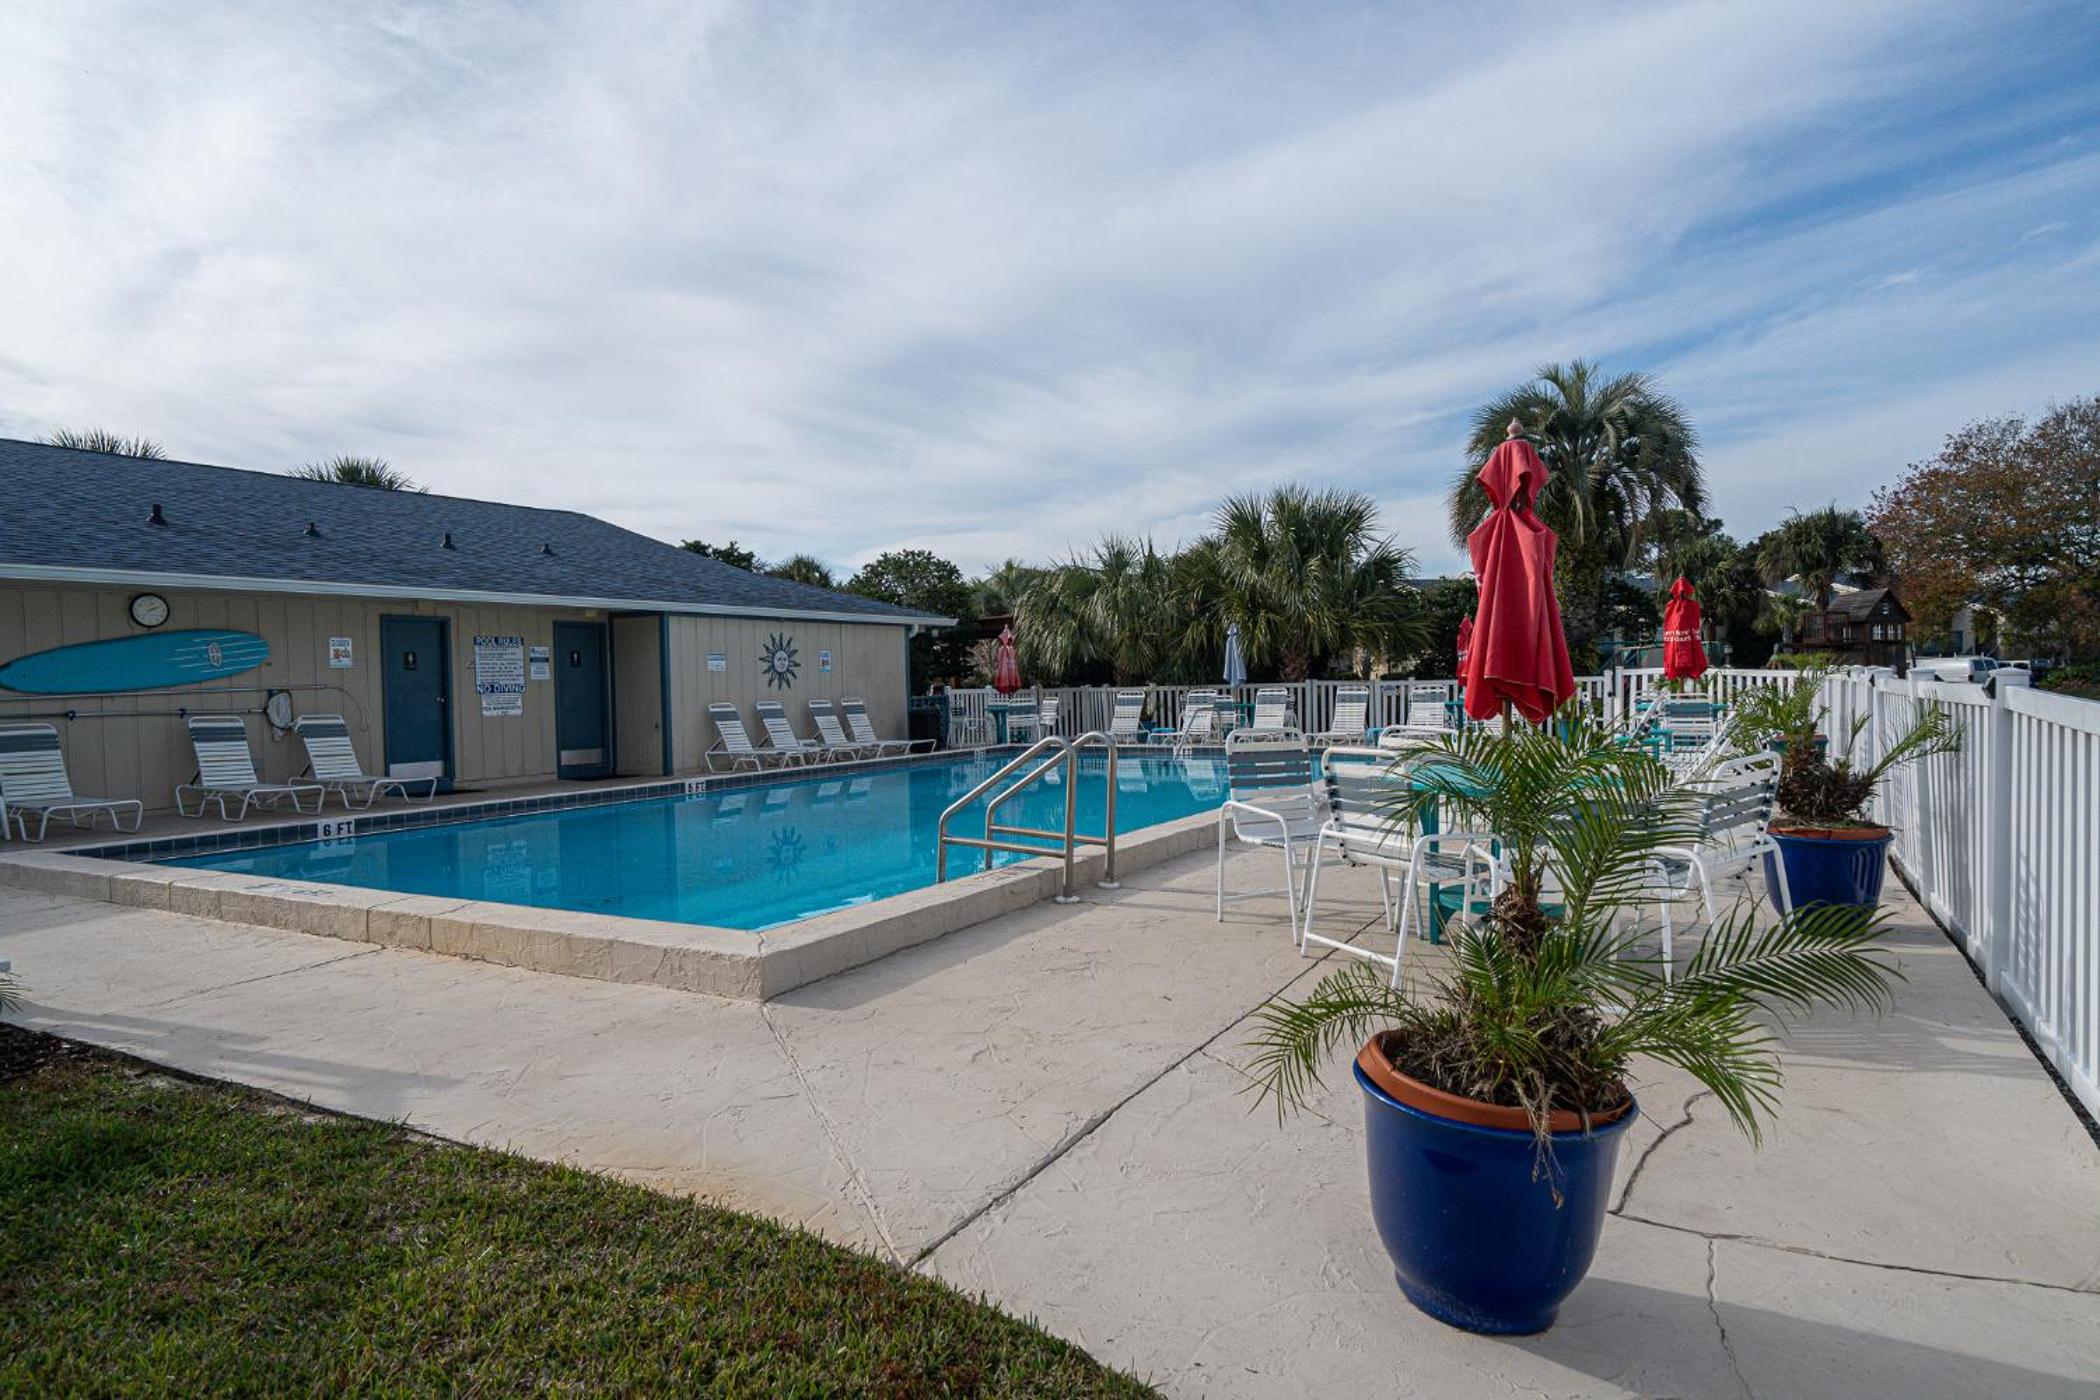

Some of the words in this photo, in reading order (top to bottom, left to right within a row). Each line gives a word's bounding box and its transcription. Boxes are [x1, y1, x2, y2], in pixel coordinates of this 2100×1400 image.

[476, 637, 496, 646] POOL
[498, 637, 521, 647] RULES
[477, 684, 491, 693] NO
[494, 684, 525, 693] DIVING
[323, 824, 331, 836] 6
[337, 821, 352, 834] FT
